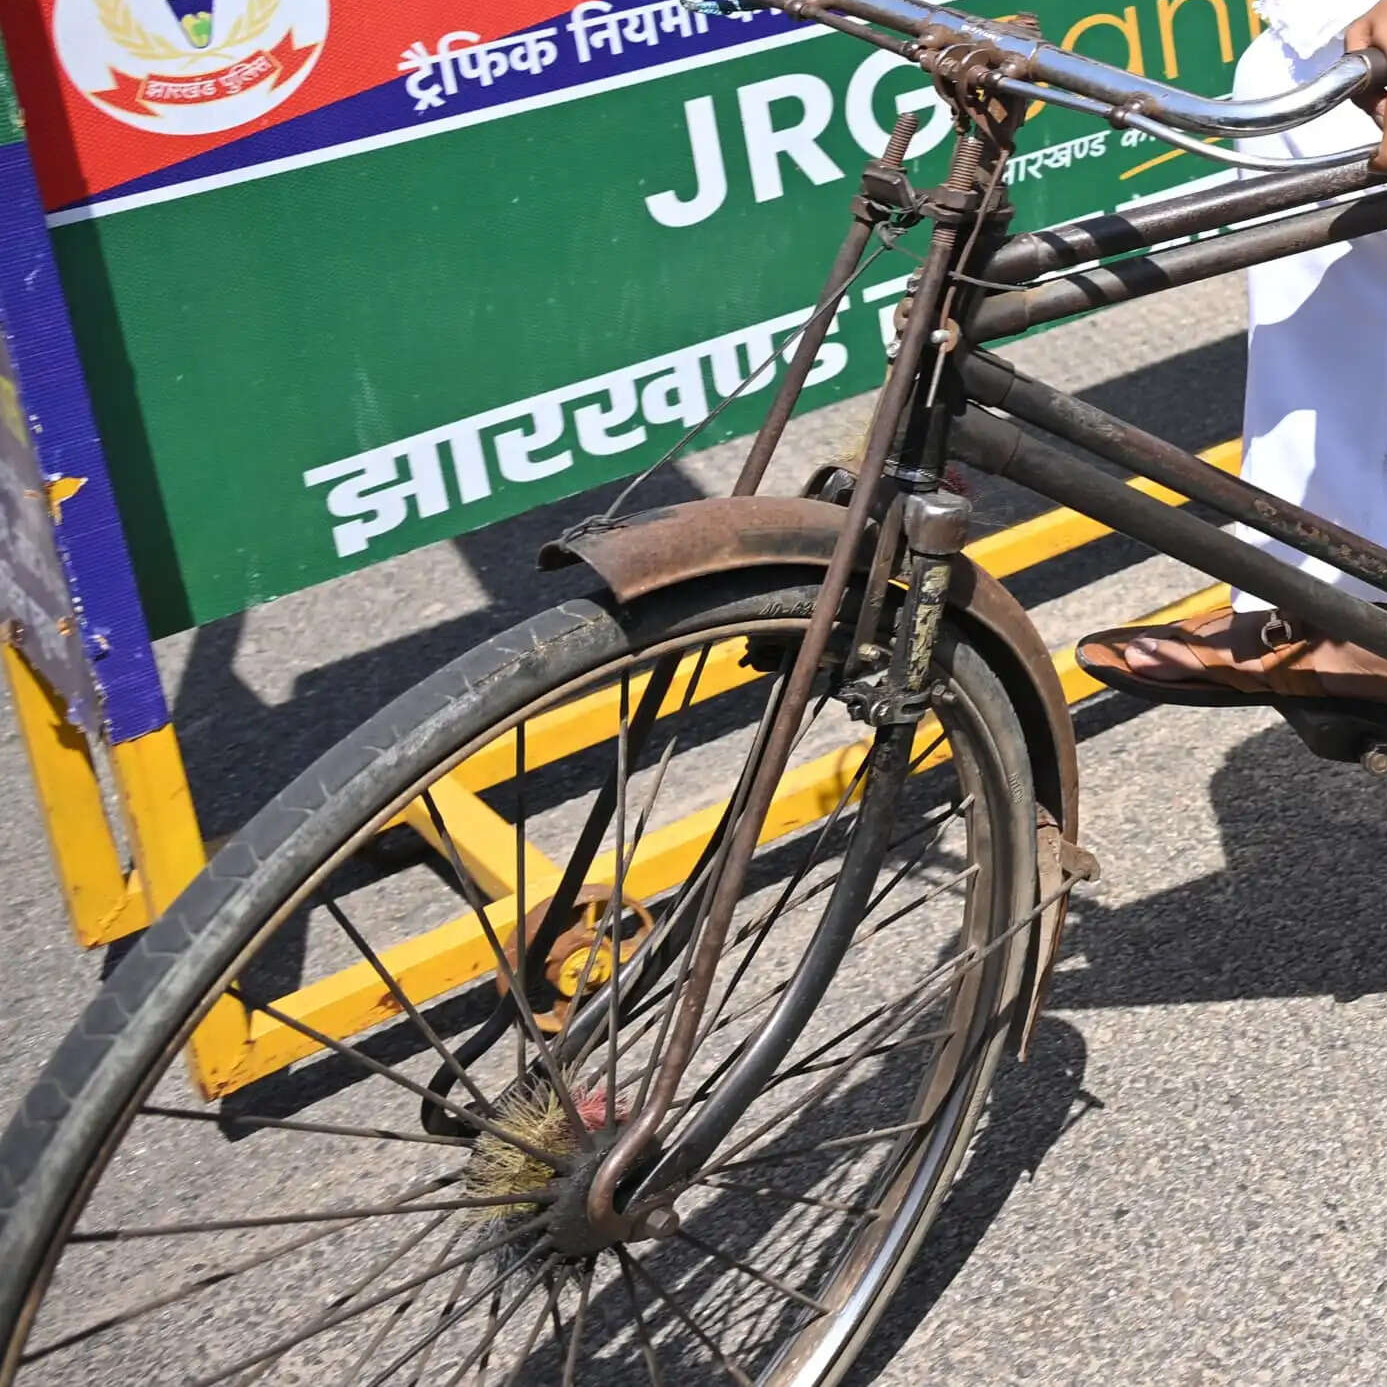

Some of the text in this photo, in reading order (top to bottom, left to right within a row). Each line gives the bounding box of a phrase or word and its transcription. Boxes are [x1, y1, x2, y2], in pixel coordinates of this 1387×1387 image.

[146, 54, 272, 100] झारखंड पुलिस
[397, 30, 558, 111] ट्रैफिक
[644, 49, 957, 229] JRG
[303, 296, 851, 558] झारखण्ड
